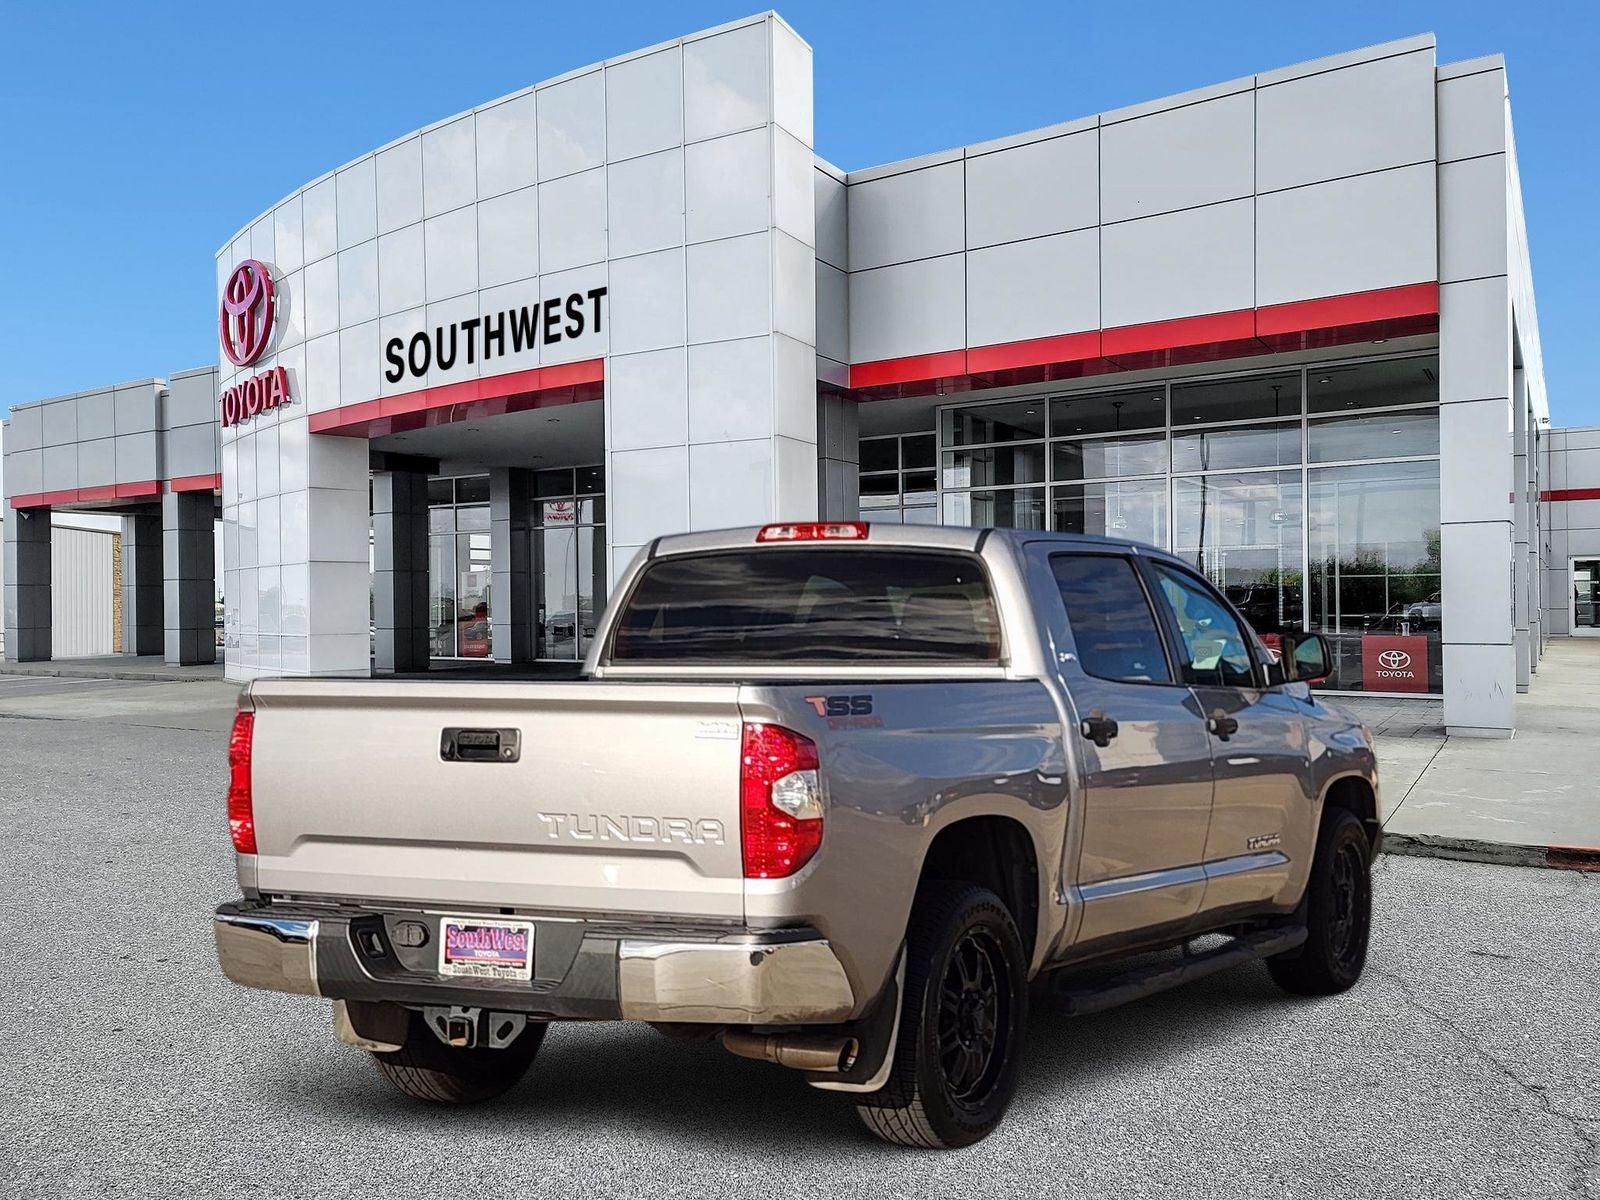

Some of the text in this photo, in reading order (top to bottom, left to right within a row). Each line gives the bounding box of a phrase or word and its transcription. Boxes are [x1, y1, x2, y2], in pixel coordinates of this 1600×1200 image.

[385, 286, 608, 384] SOUTHWEST
[218, 366, 288, 428] TOYOTA
[1375, 670, 1415, 679] TOYOTA
[804, 694, 873, 718] TSS
[537, 812, 725, 846] TUNDRA
